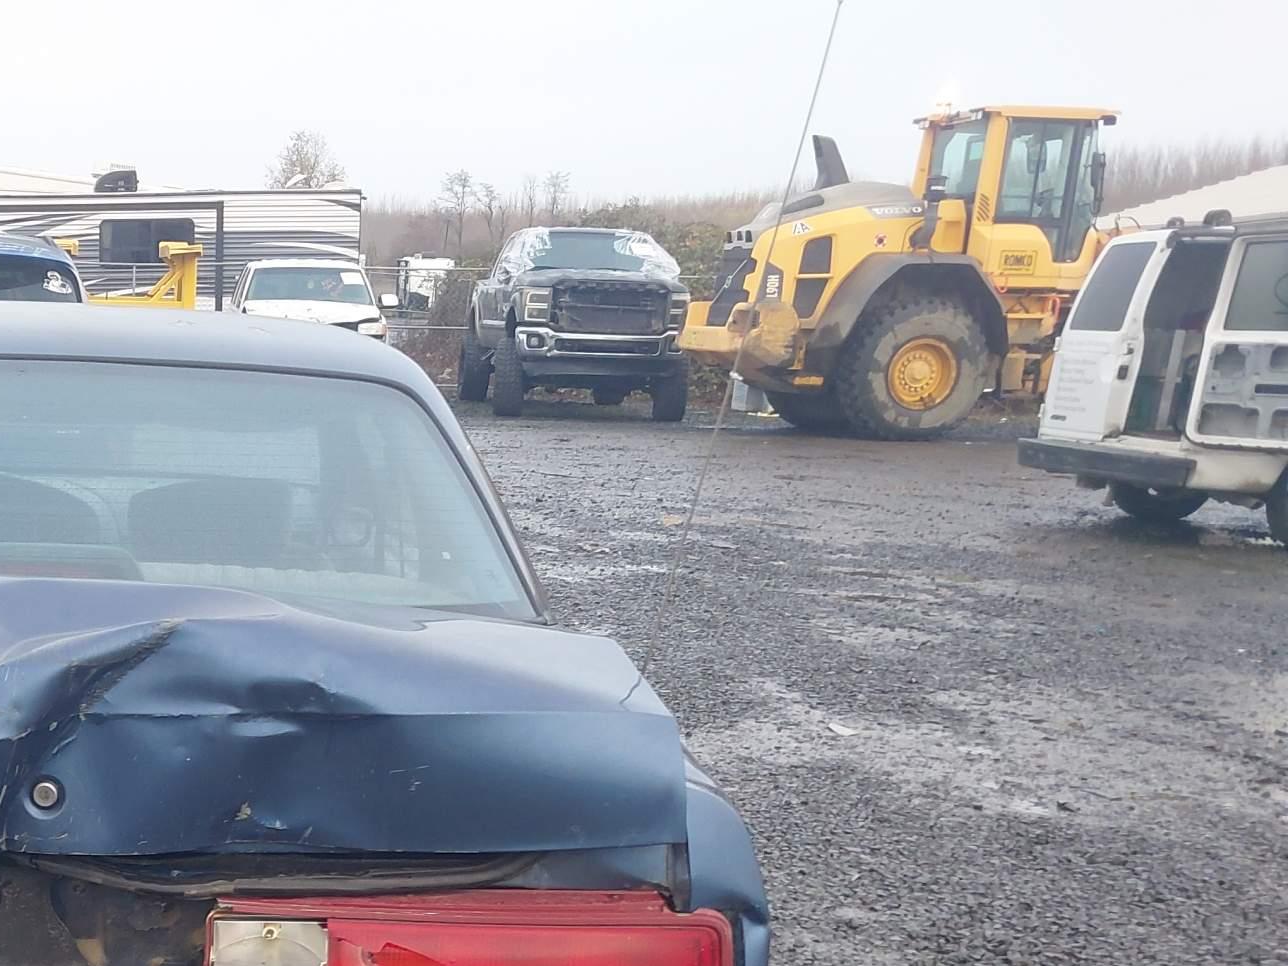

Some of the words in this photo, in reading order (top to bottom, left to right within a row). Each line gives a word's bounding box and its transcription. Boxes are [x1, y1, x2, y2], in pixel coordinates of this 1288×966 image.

[871, 206, 923, 216] VOLVO
[1004, 253, 1034, 267] ROMCO
[765, 274, 780, 298] L90H
